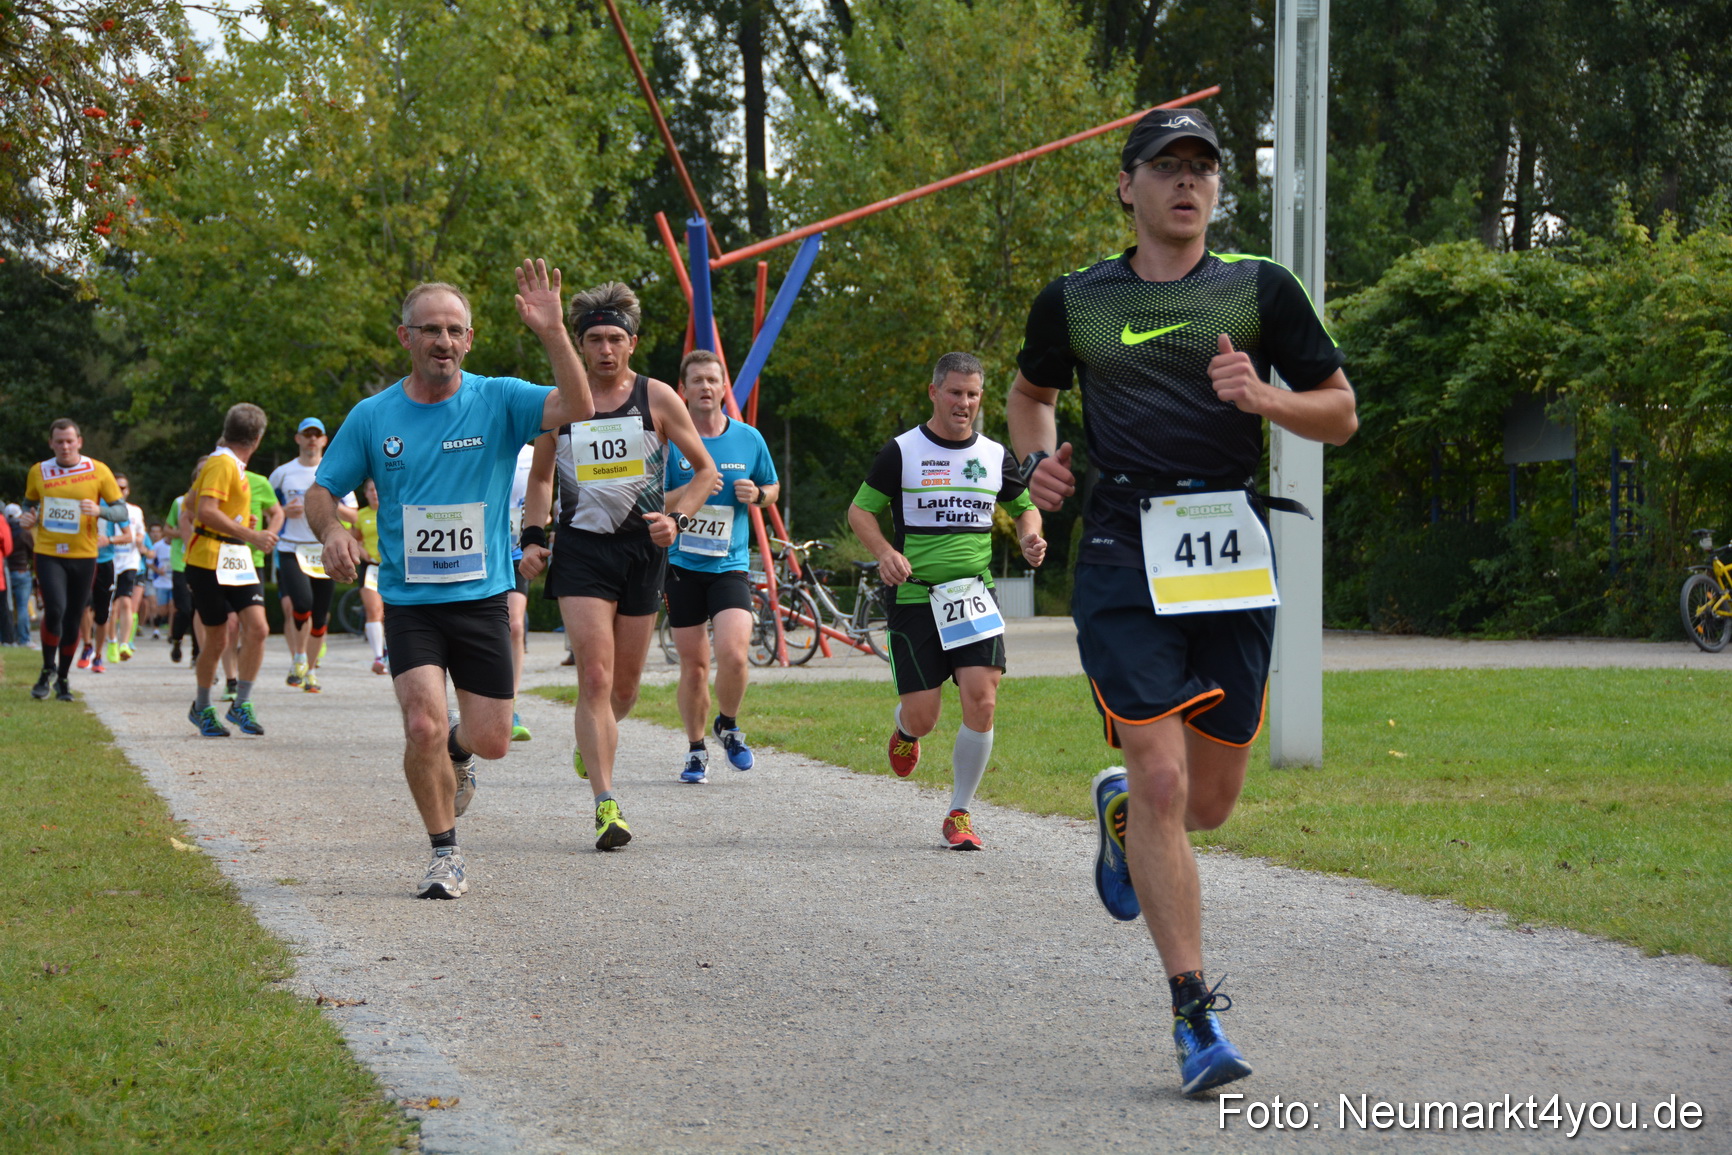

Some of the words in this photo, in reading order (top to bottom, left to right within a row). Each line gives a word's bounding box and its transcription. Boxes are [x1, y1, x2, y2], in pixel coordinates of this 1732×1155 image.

[442, 436, 484, 450] BOCK
[589, 438, 627, 460] 103
[592, 466, 628, 475] Sebastian
[917, 496, 992, 511] Laufteam
[1189, 503, 1233, 516] BOCK
[49, 508, 75, 521] 2625
[935, 510, 979, 522] Fürth
[688, 518, 726, 536] 2747
[416, 527, 473, 552] 2216
[1174, 529, 1242, 568] 414
[222, 557, 248, 570] 2630
[433, 560, 460, 569] Hubert
[943, 596, 987, 622] 2776
